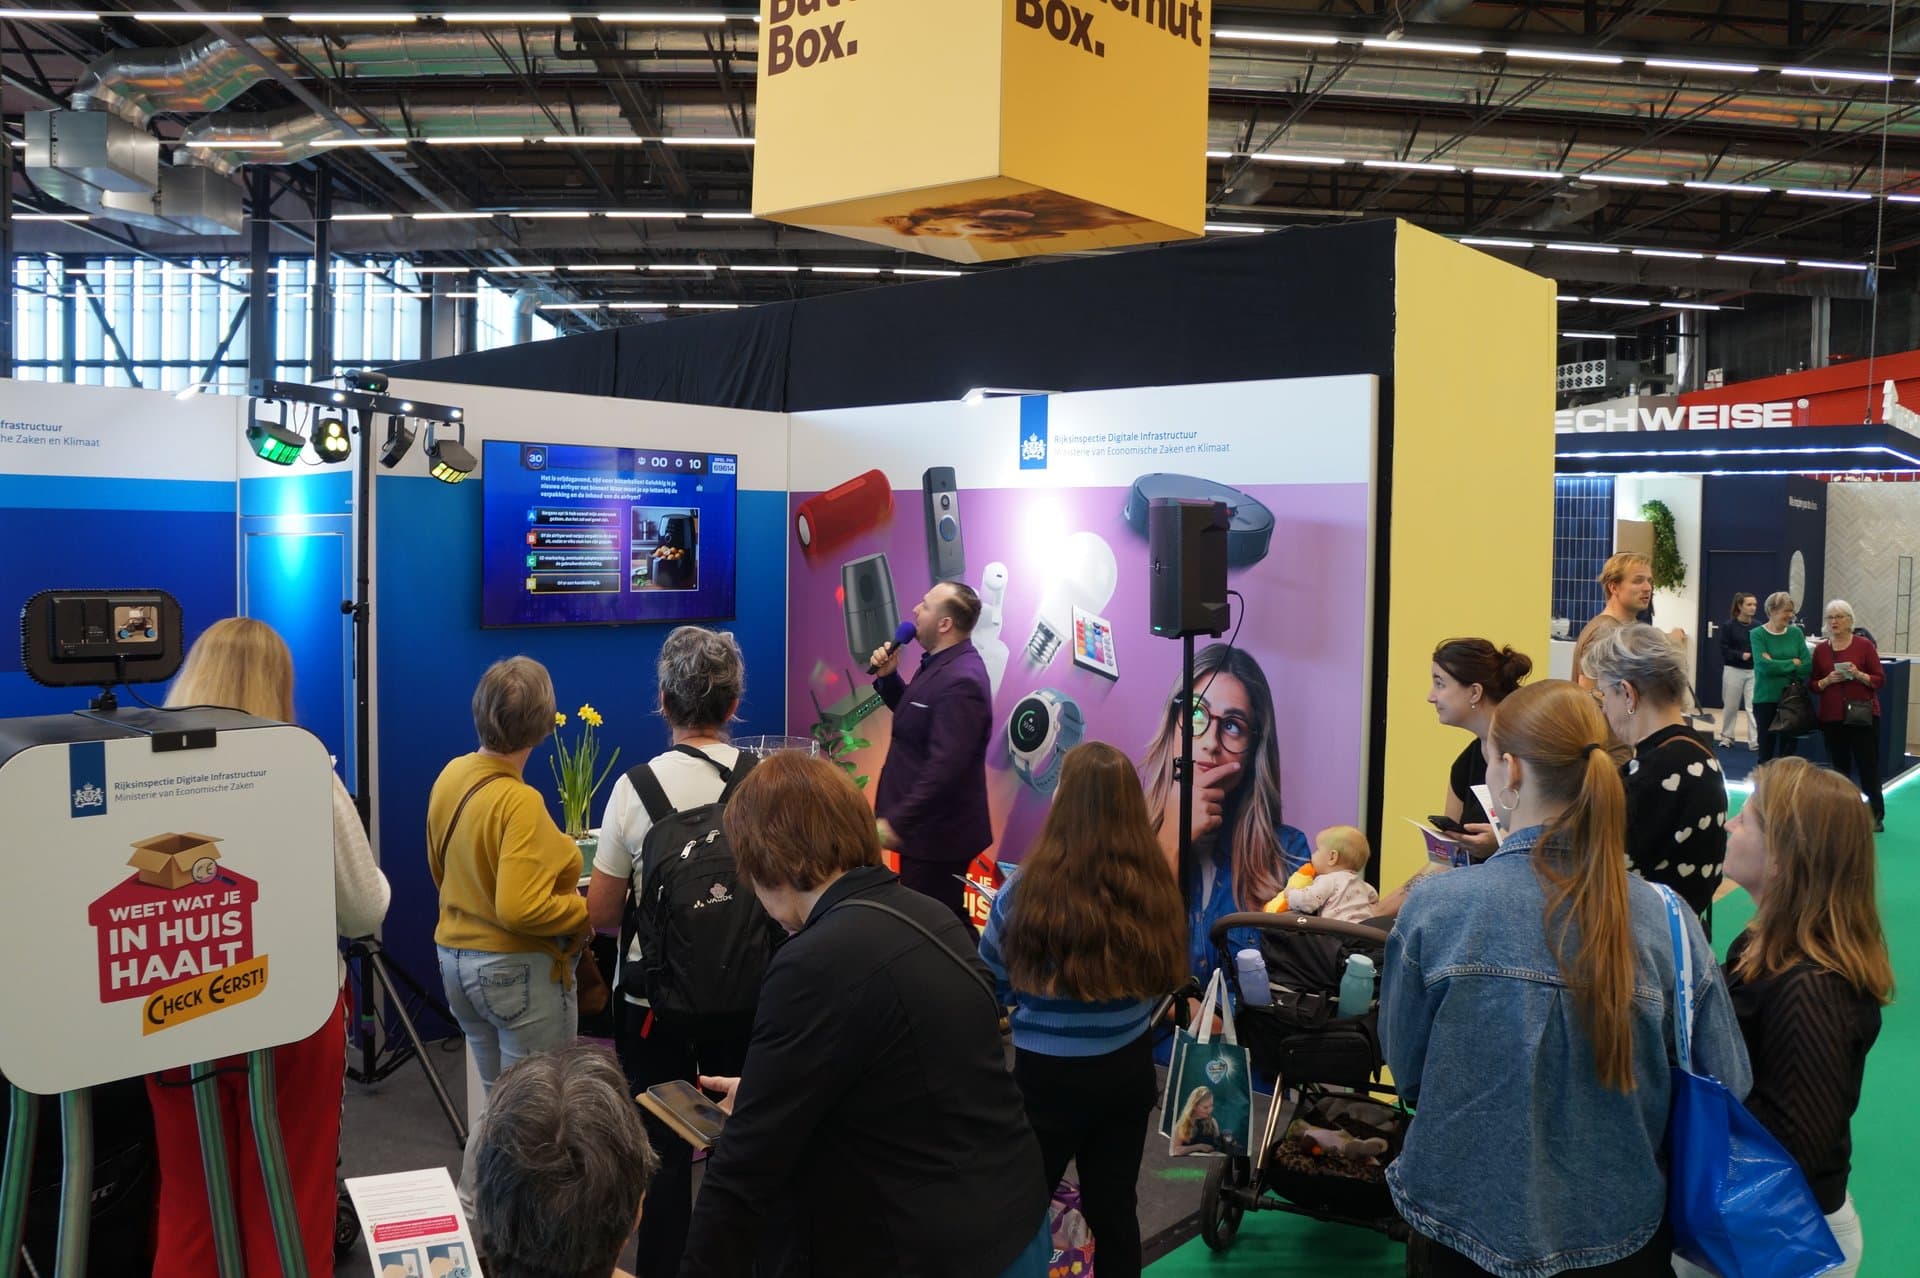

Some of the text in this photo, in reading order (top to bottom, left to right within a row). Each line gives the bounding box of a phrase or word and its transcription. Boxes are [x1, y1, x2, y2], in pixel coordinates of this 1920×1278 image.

[768, 21, 858, 76] Box.
[0, 420, 63, 432] frastructuur
[1554, 402, 1793, 434] ECHWEISE
[16, 434, 46, 445] Zaken
[48, 438, 61, 446] en
[63, 437, 100, 448] Klimaat
[1054, 431, 1197, 445] Rijksinspectie Digitale Infrastructuur
[529, 454, 543, 463] 30
[1092, 448, 1106, 456] van
[1107, 445, 1158, 456] Economische
[1159, 444, 1184, 454] Zaken
[1185, 445, 1196, 453] en
[1198, 442, 1230, 453] Klimaat
[651, 457, 668, 468] 00
[689, 459, 702, 469] 10
[114, 769, 267, 791] Rijksinspectie Digitale Infrastructuur
[114, 781, 255, 802] Ministerie van Economische Zaken
[109, 890, 241, 922] WEET WAT JE
[109, 910, 243, 956] IN HUIS
[110, 941, 243, 990] HAALT
